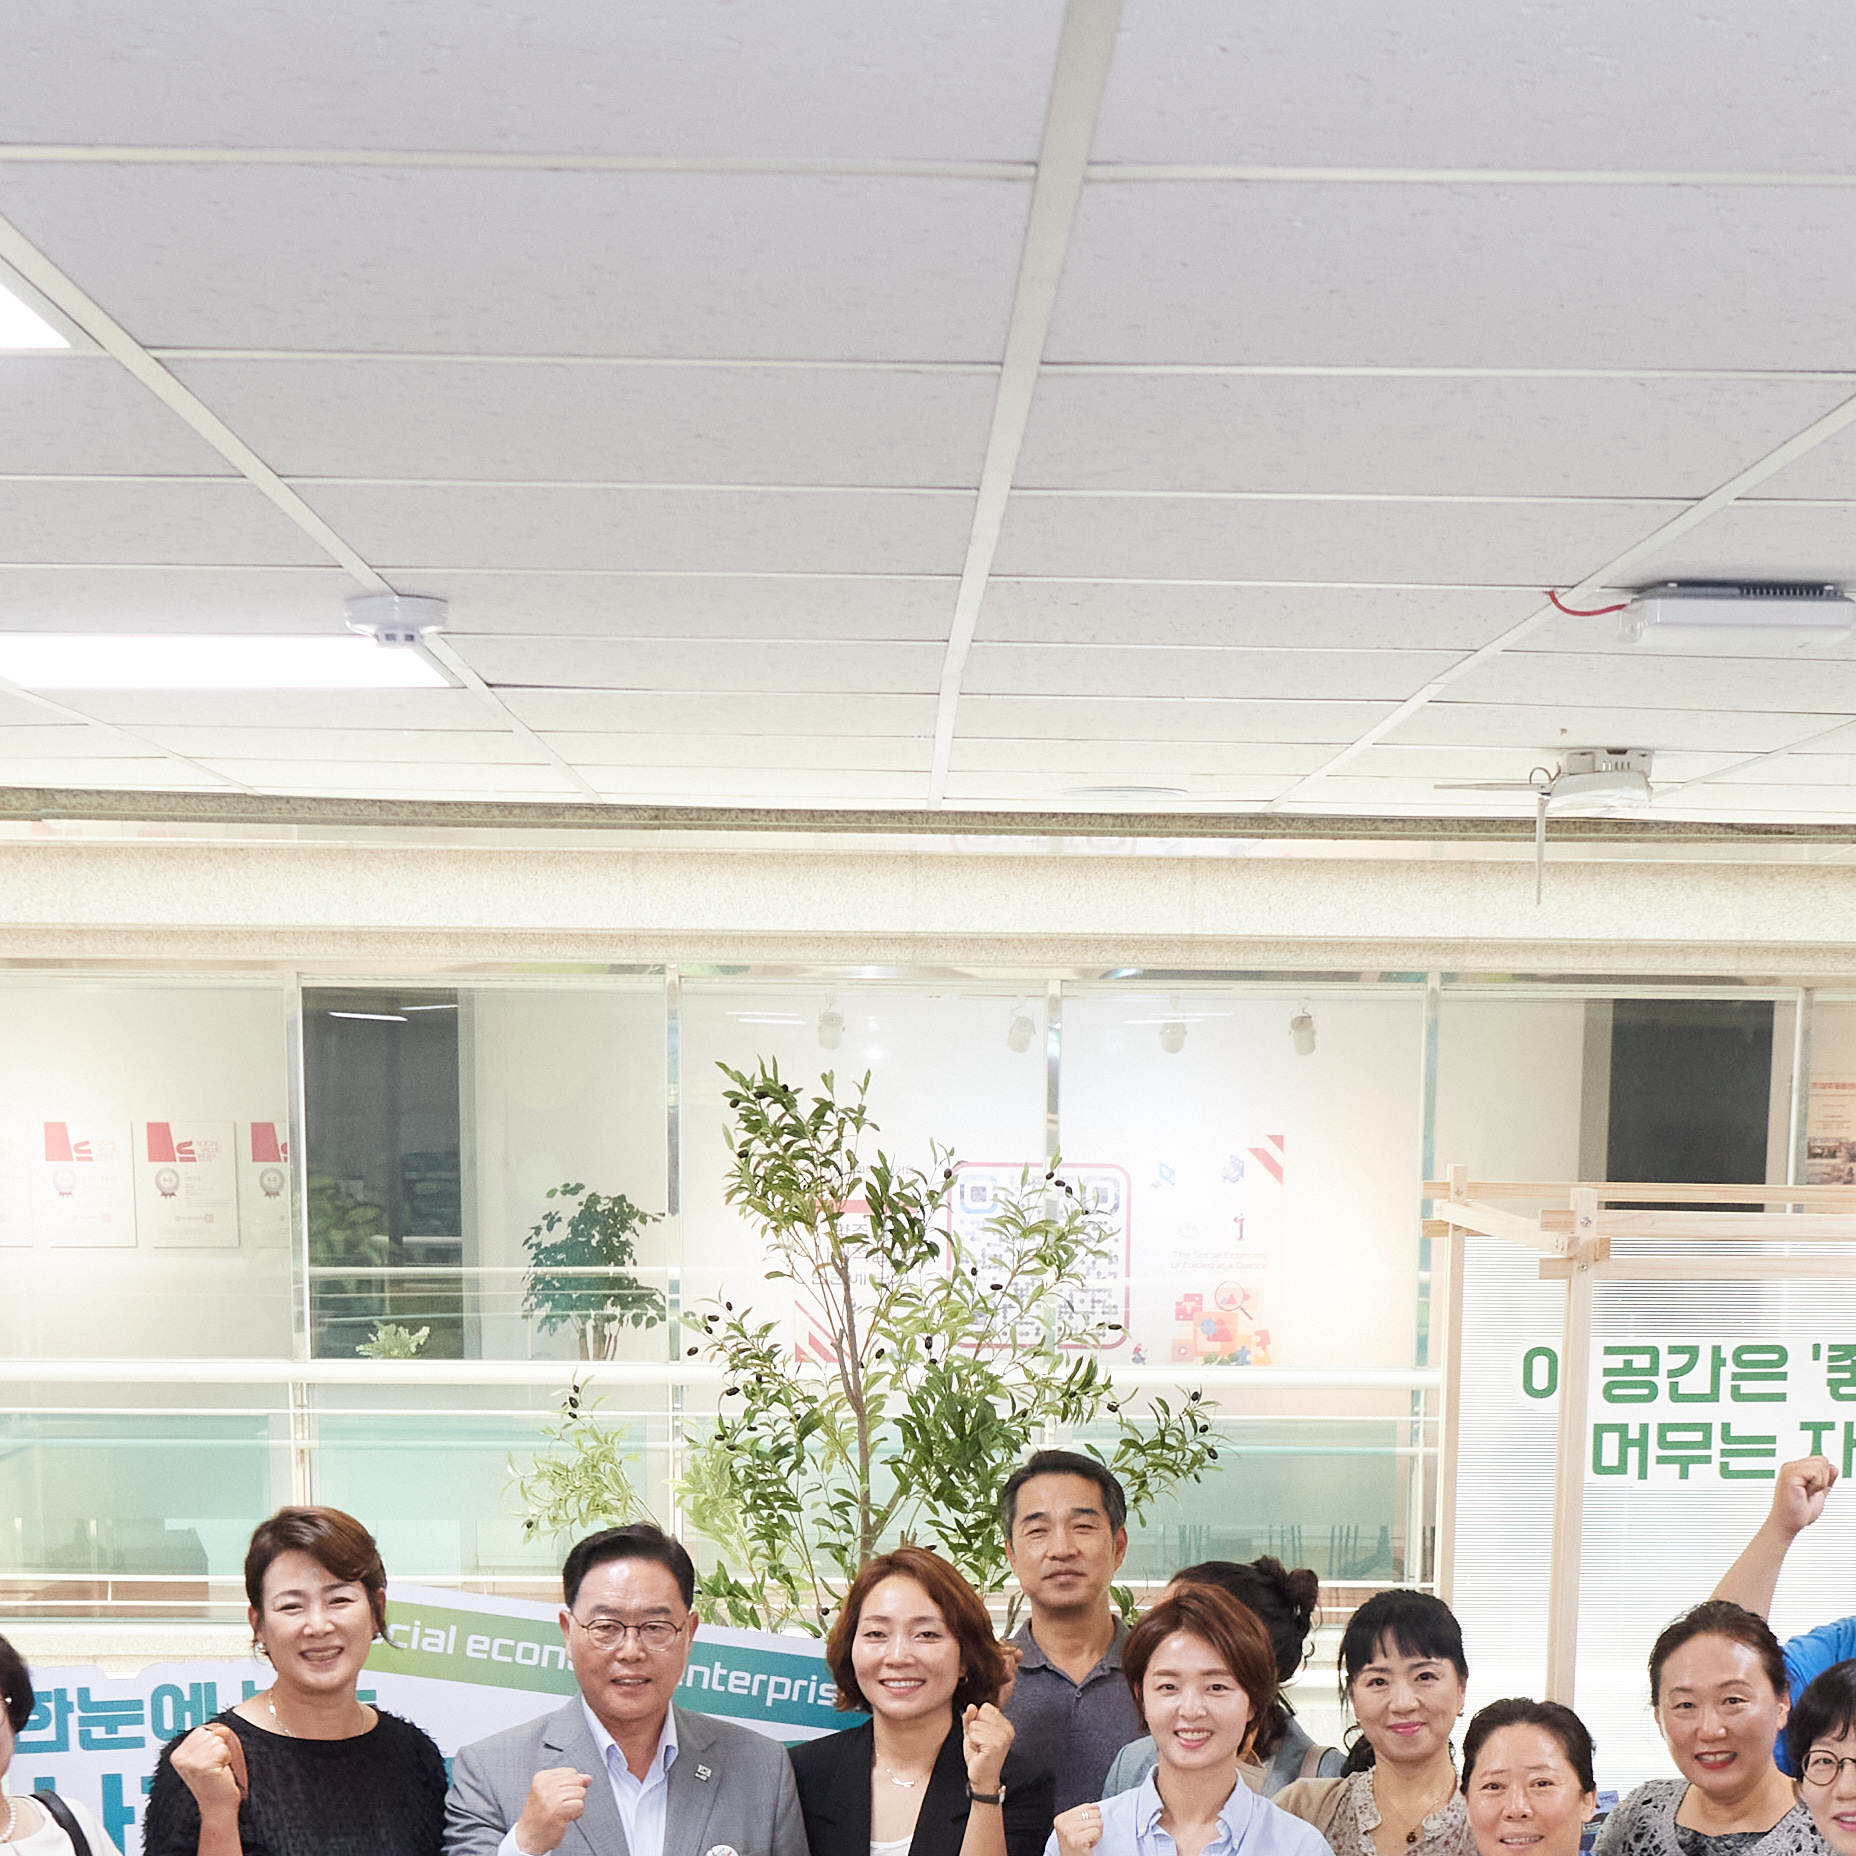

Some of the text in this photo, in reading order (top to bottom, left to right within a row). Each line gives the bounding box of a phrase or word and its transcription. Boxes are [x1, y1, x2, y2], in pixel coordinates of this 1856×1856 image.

[1602, 1344, 1789, 1404] 공간은
[1592, 1421, 1777, 1481] 머무는
[372, 1620, 838, 1707] cial econ nterpris
[14, 1681, 218, 1755] 한눈에
